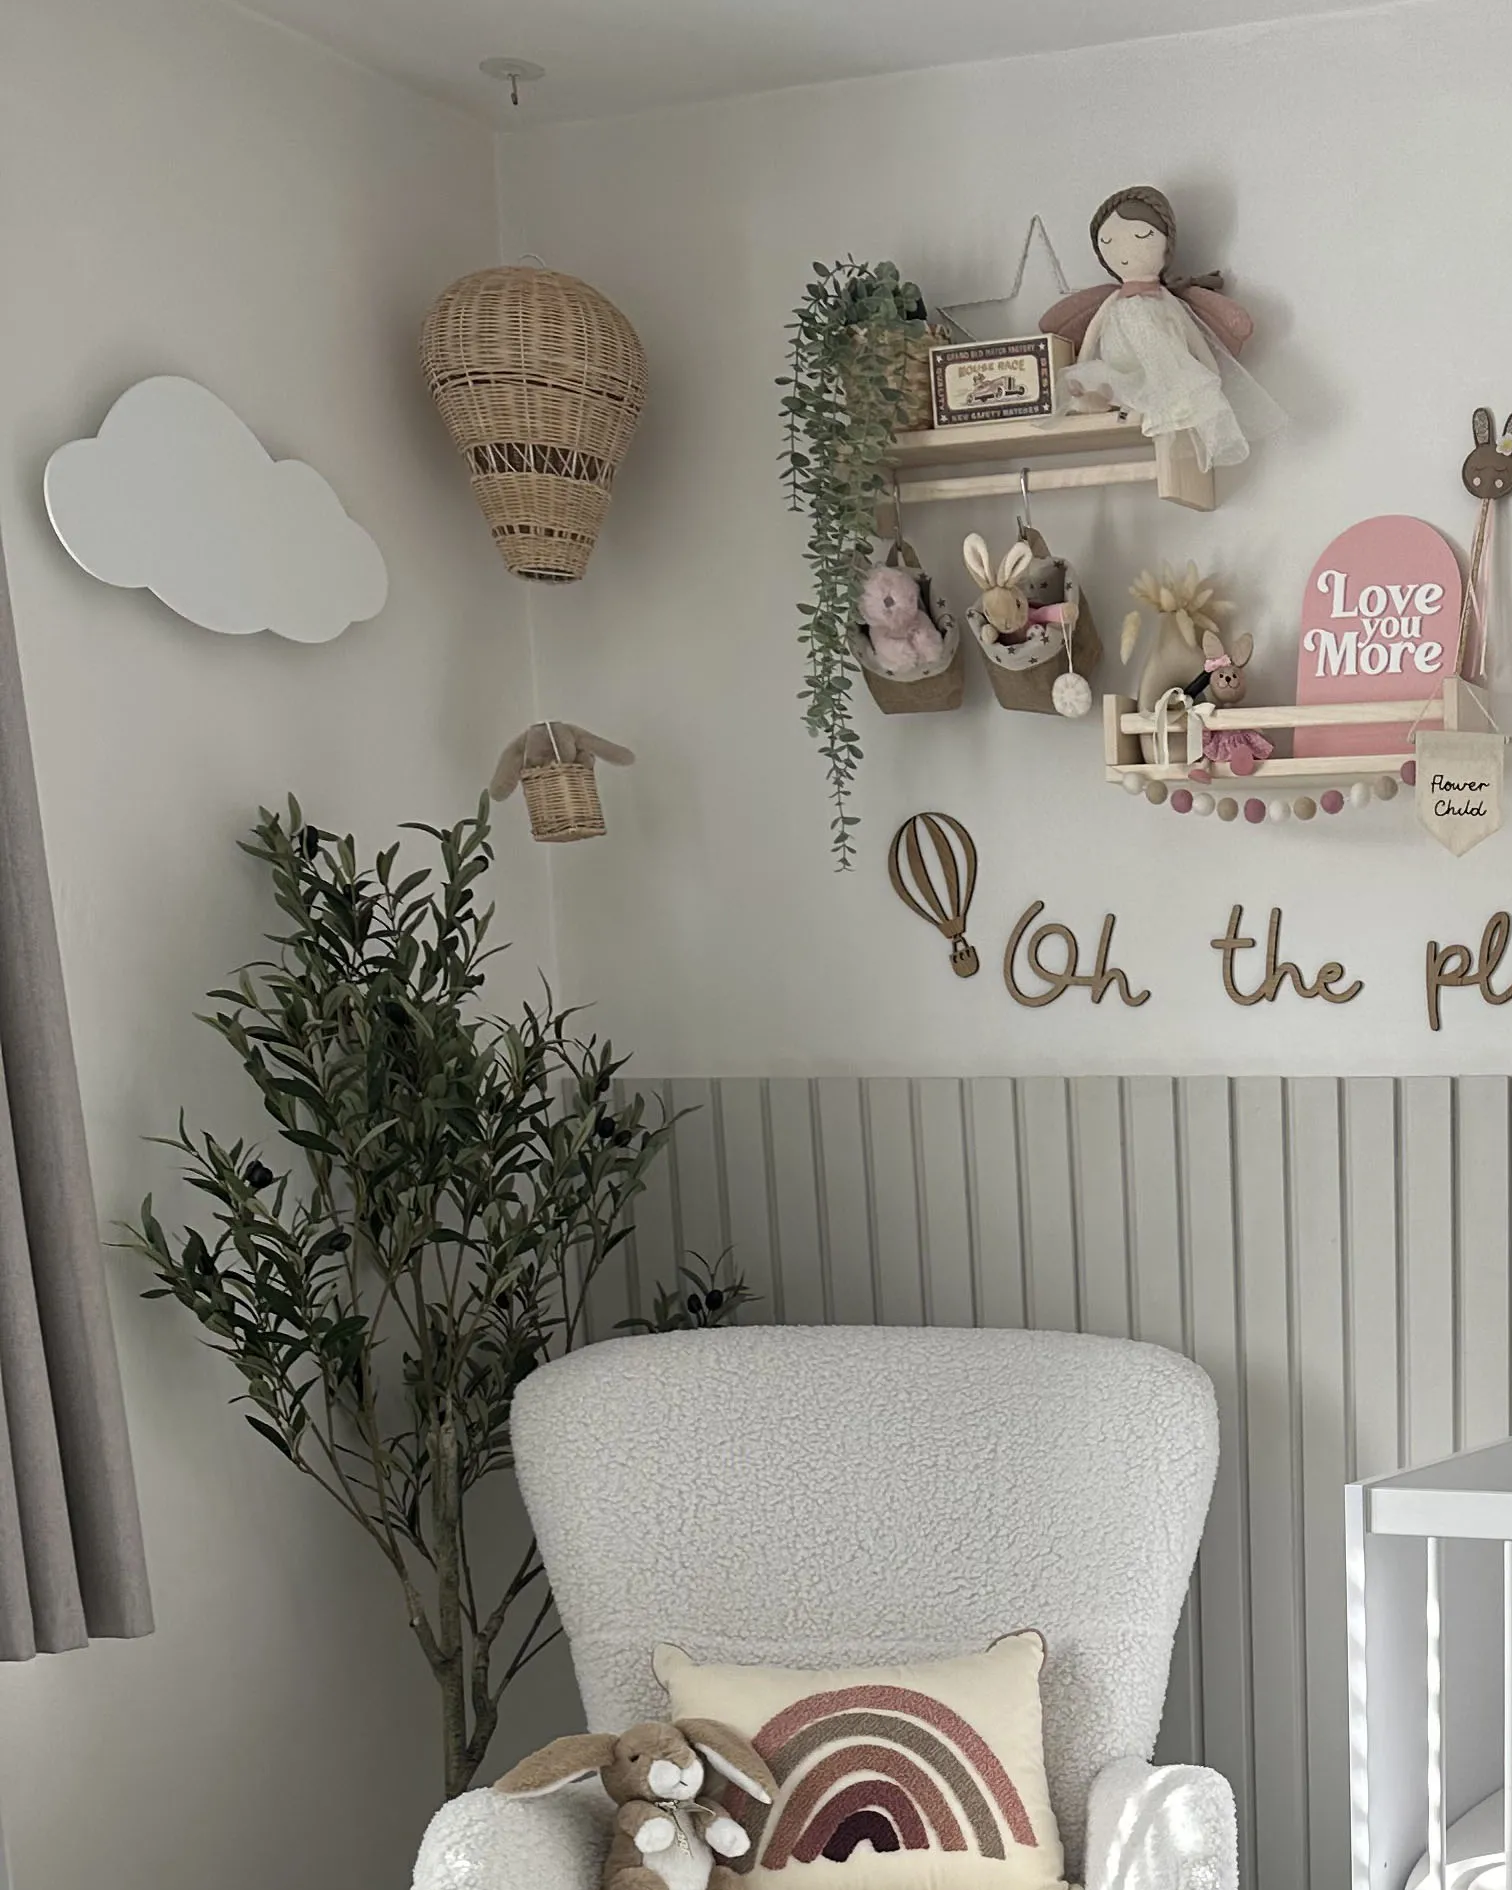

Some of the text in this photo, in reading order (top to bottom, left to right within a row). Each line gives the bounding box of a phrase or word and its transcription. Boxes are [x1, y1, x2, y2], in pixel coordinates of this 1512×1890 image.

[998, 359, 1025, 372] RACE
[1317, 569, 1444, 618] Love
[1358, 615, 1422, 648] you
[1303, 628, 1443, 677] More
[1434, 799, 1487, 816] Child
[1003, 900, 1150, 1007] Oh
[1210, 904, 1362, 1006] the
